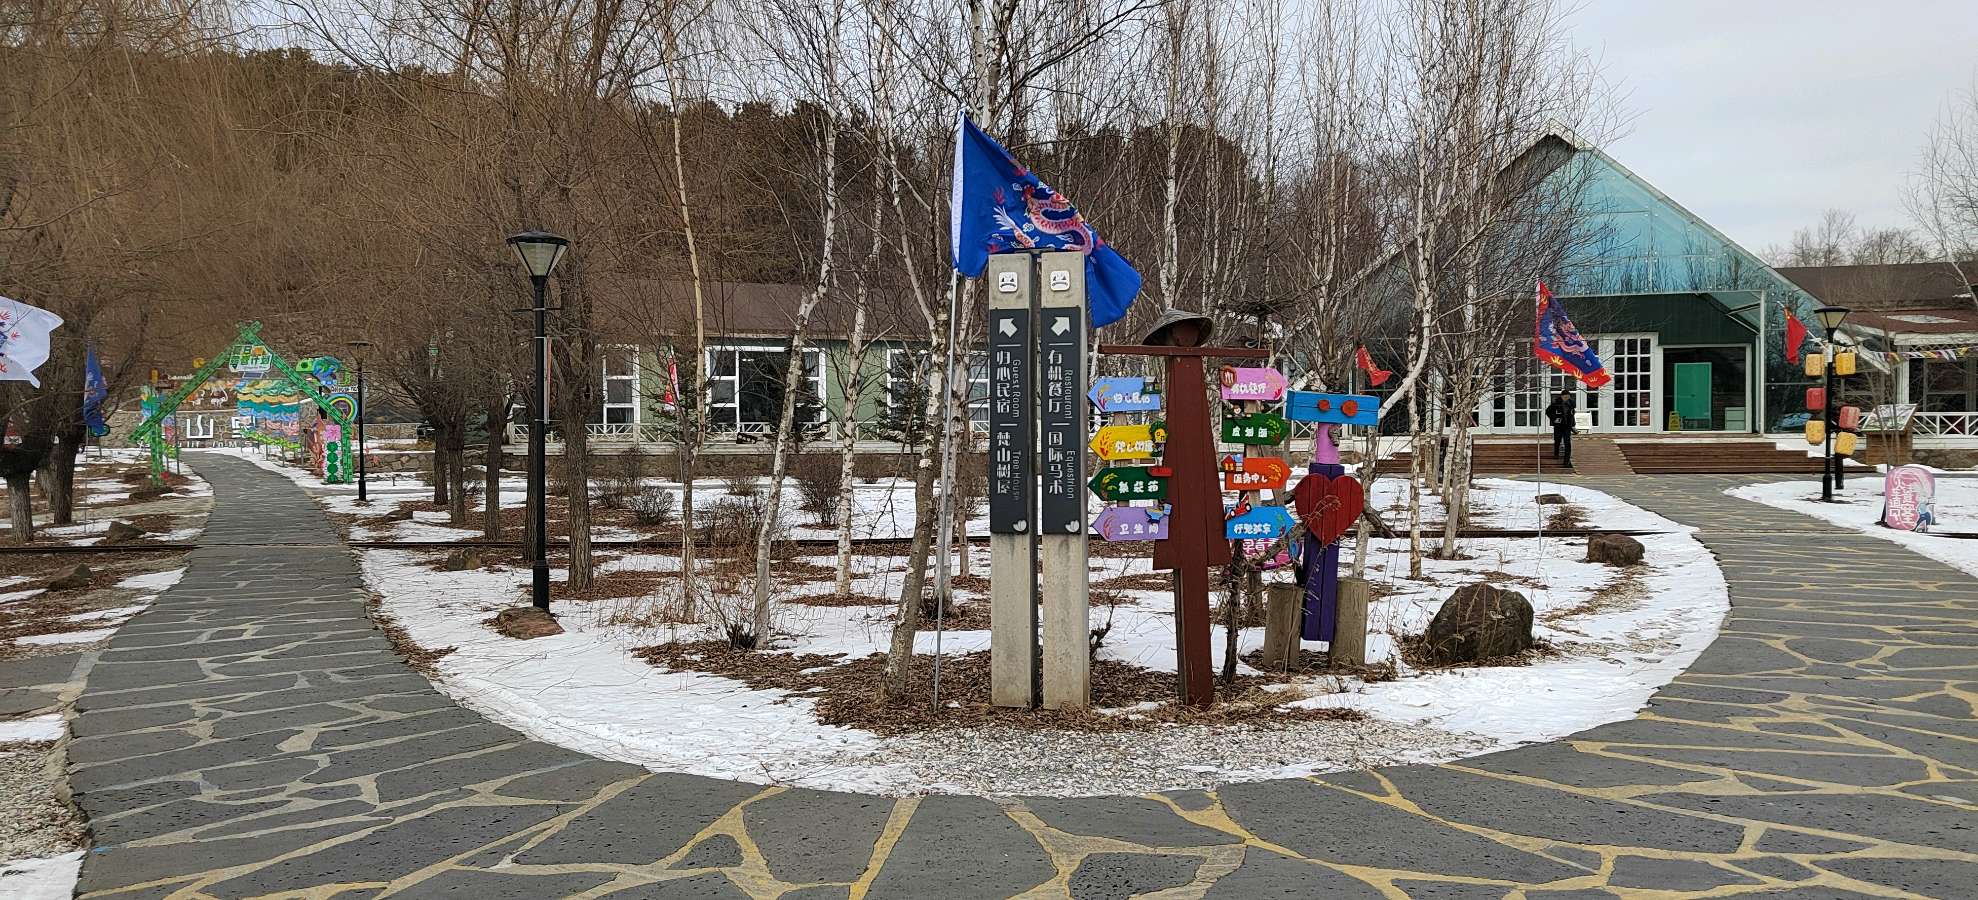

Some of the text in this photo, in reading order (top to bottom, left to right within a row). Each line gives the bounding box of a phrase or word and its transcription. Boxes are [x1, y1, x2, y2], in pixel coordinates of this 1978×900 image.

[996, 350, 1011, 414] 归心民宿
[1012, 359, 1022, 418] Guest Room
[1048, 349, 1062, 413] 有机餐厅
[1048, 431, 1063, 495] 国际马术
[1233, 472, 1268, 484] 服务中心
[1119, 523, 1159, 535] 卫生间
